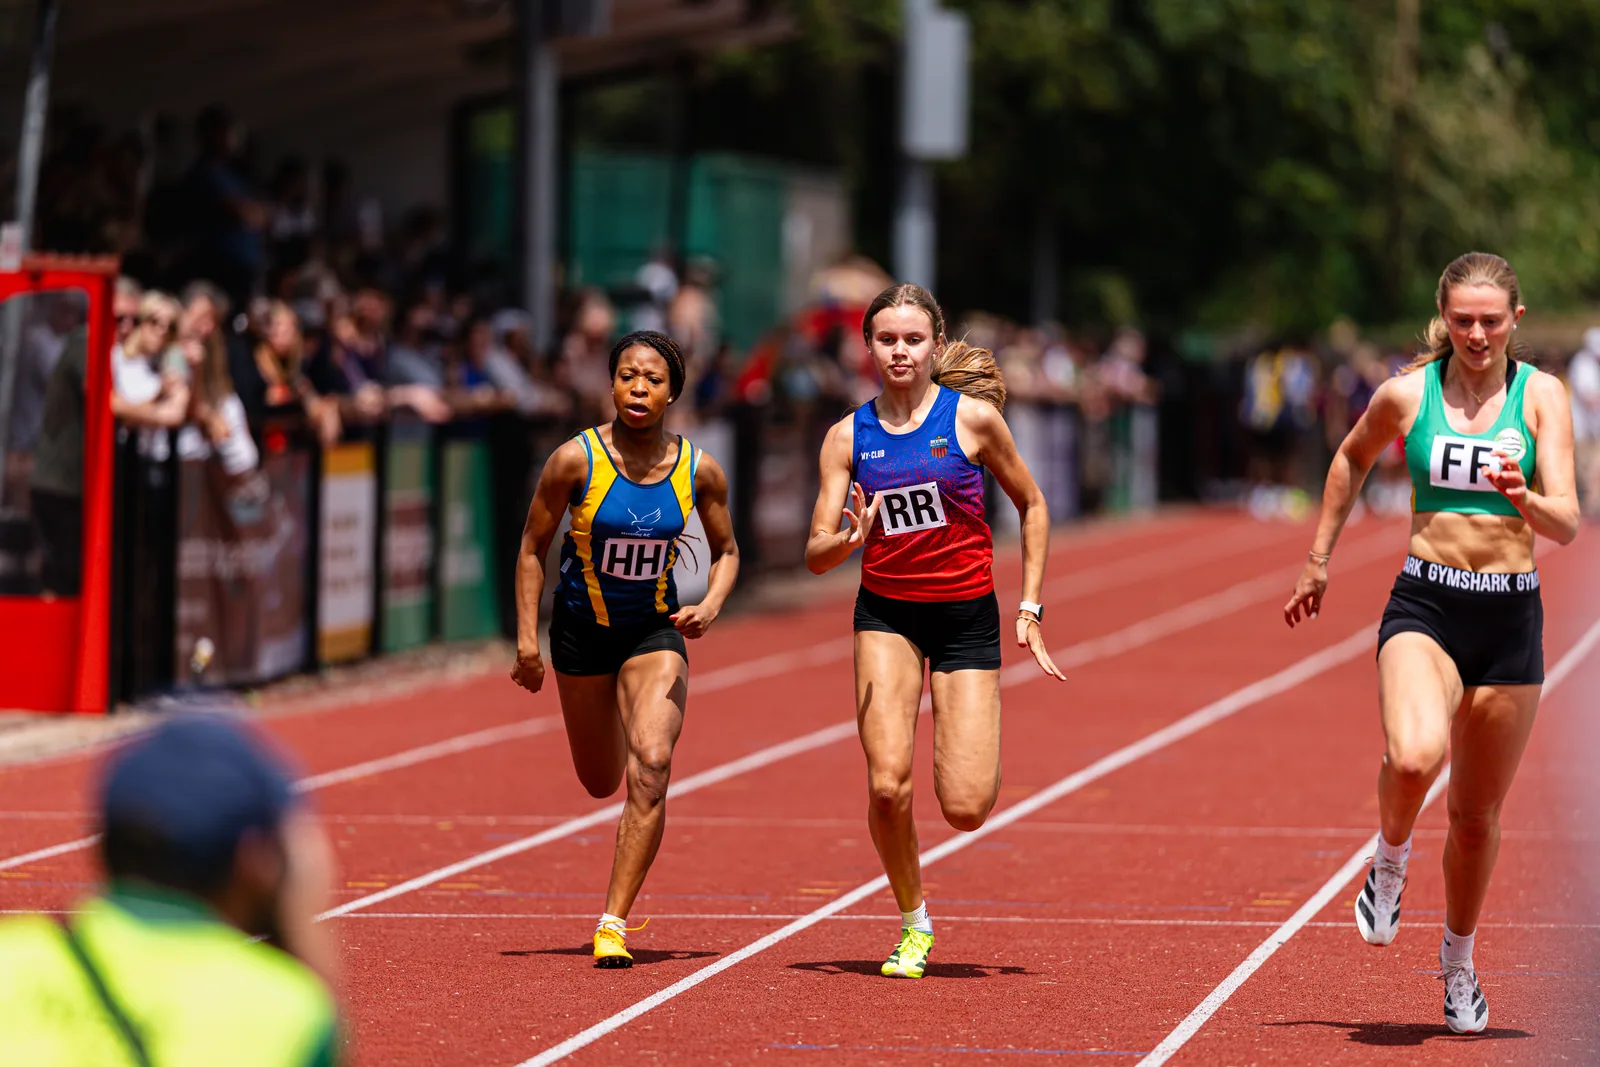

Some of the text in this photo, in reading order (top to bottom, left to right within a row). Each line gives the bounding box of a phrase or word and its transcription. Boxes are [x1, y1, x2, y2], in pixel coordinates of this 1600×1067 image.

[1441, 442, 1493, 484] FF
[883, 489, 939, 529] RR
[606, 543, 662, 577] HH
[1427, 562, 1511, 592] GYMSHARK
